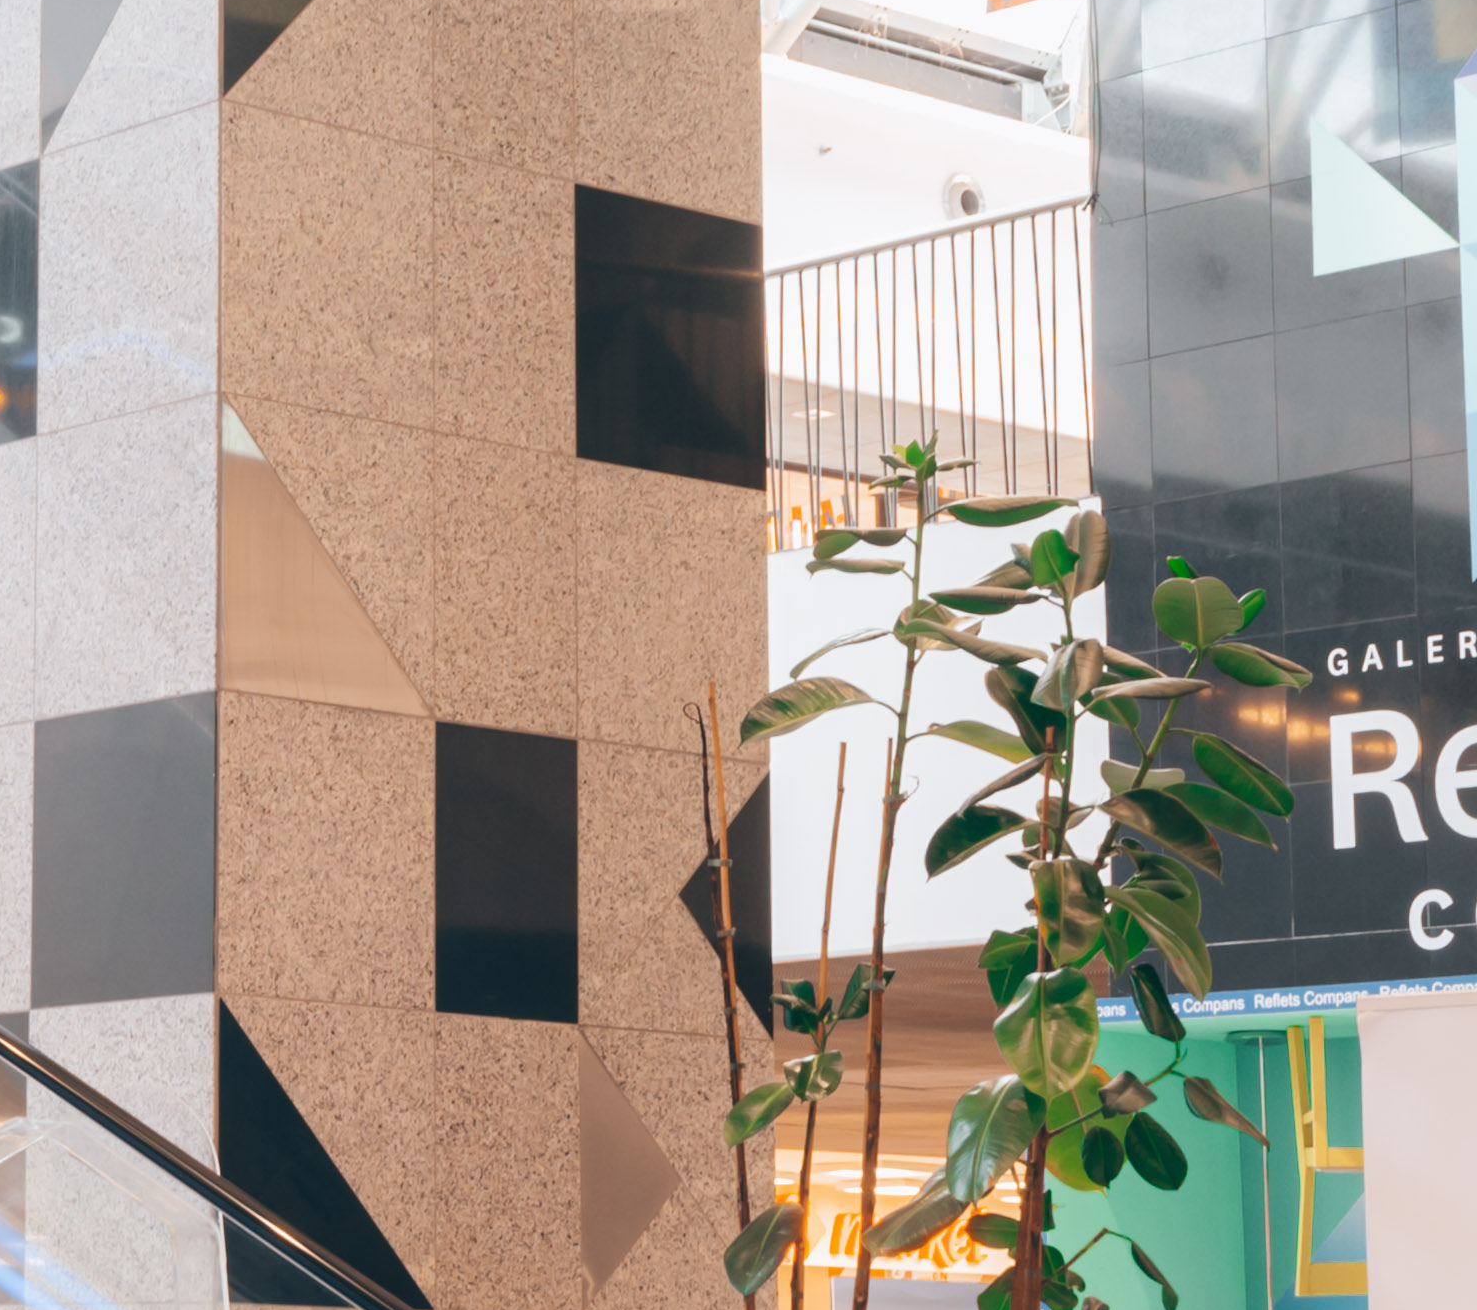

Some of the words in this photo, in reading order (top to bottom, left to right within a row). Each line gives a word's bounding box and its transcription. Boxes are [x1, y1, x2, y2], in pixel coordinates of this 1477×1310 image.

[1182, 996, 1245, 1017] Compans
[1254, 993, 1300, 1009] Reflets
[1303, 988, 1369, 1008] Compans
